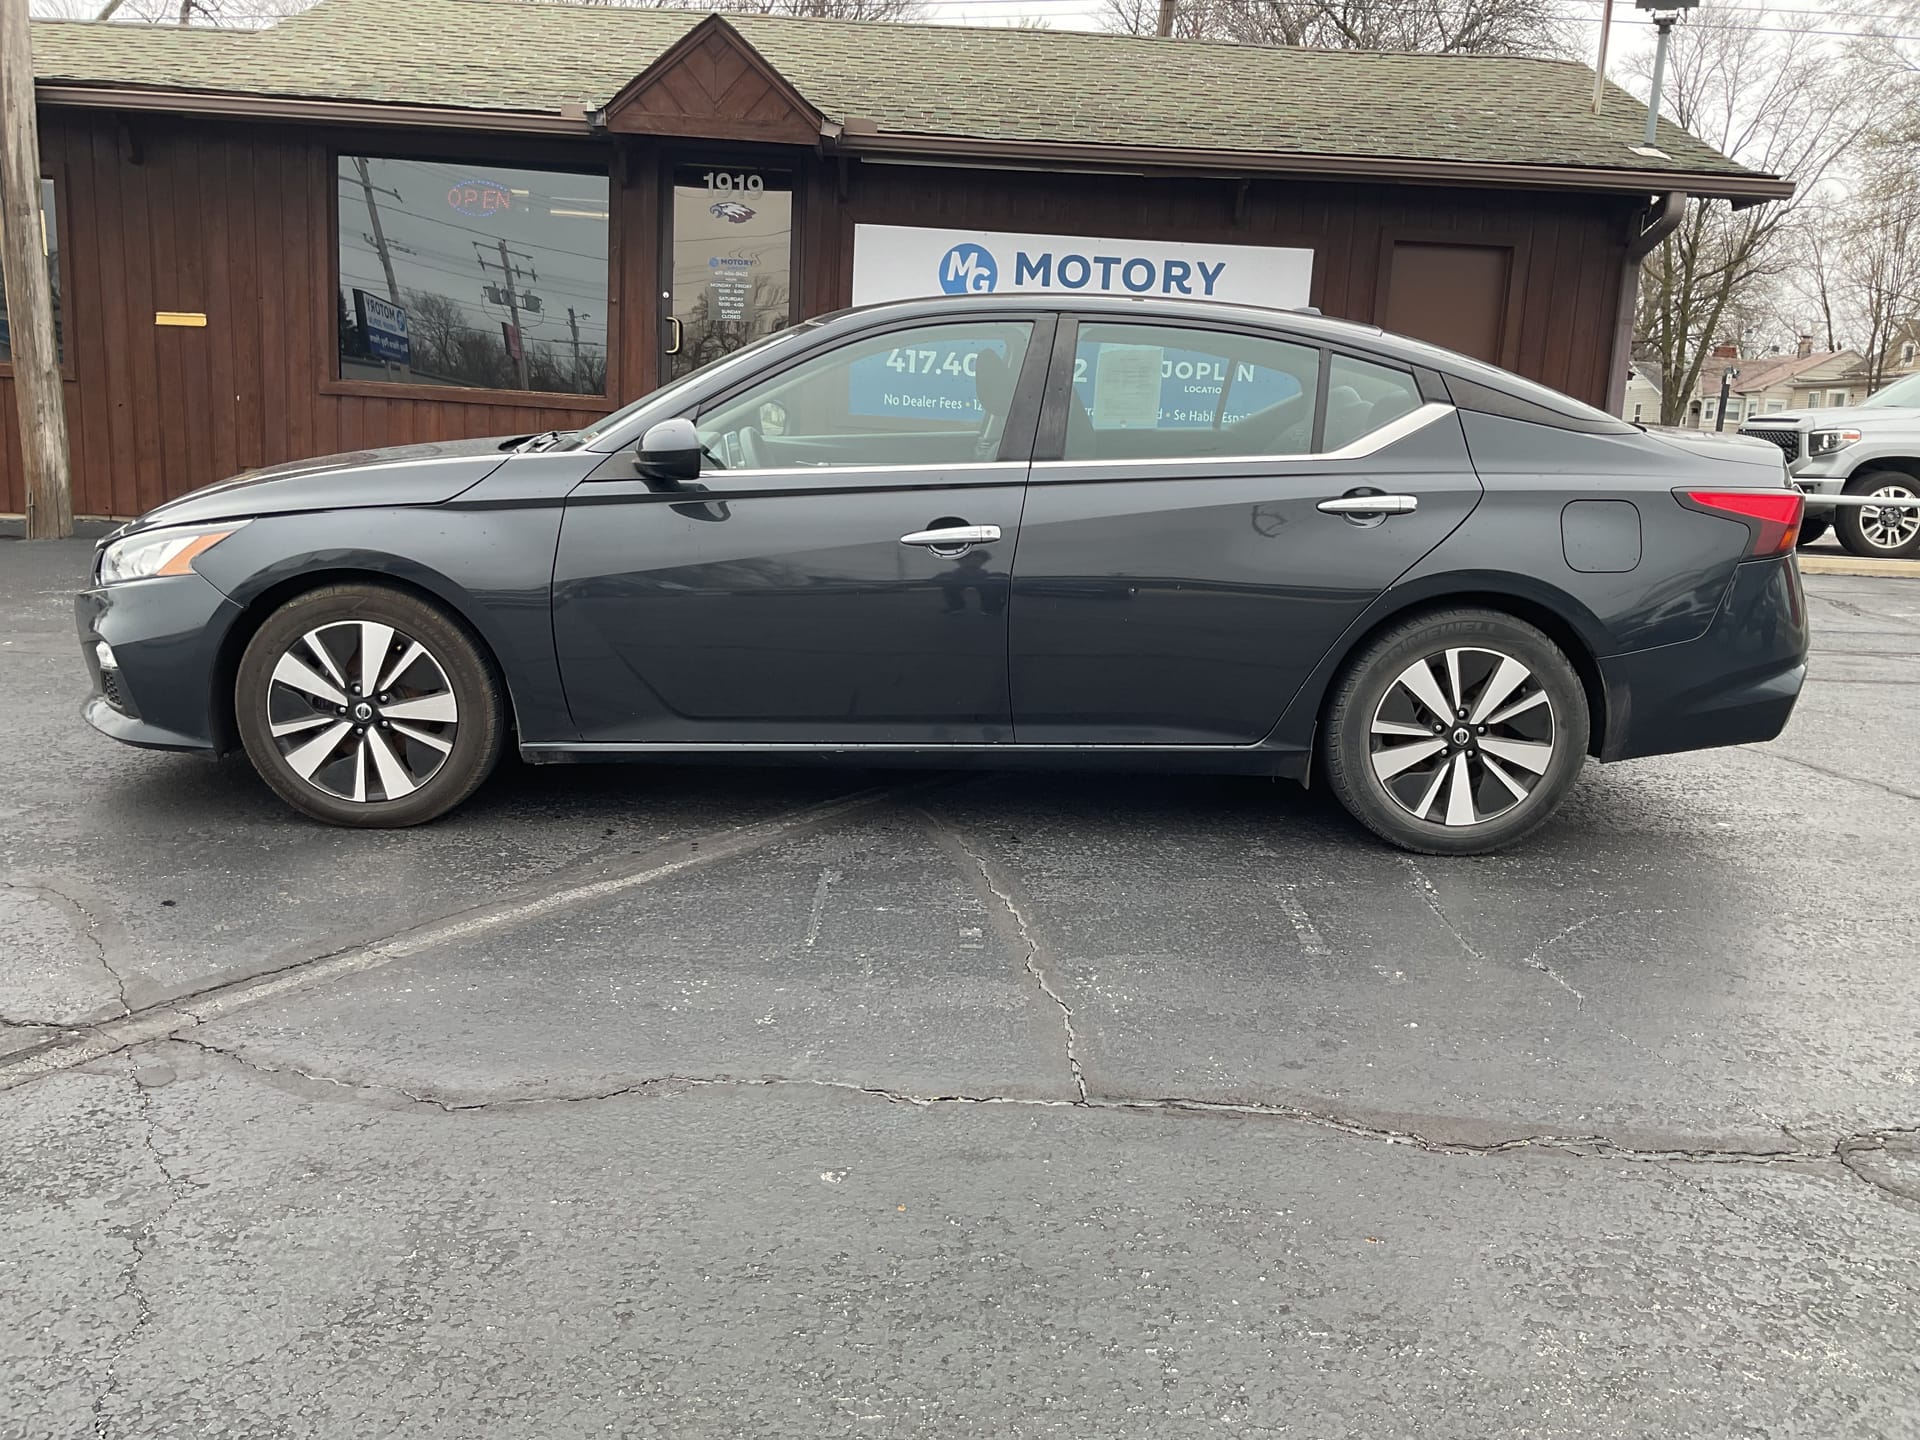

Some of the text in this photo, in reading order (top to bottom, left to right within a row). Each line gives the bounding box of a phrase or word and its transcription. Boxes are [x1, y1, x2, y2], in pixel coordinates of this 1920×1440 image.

[703, 172, 764, 200] 1919
[448, 188, 510, 208] OPEN
[721, 258, 753, 266] MOTORY
[945, 250, 1226, 296] MG MOTORY
[1161, 360, 1255, 382] JOPLN
[1184, 385, 1222, 394] LOCATIO
[884, 393, 900, 406] No
[903, 395, 937, 408] Dealer
[939, 397, 962, 410] Fees
[1174, 410, 1186, 421] Se
[1189, 410, 1216, 422] Habl
